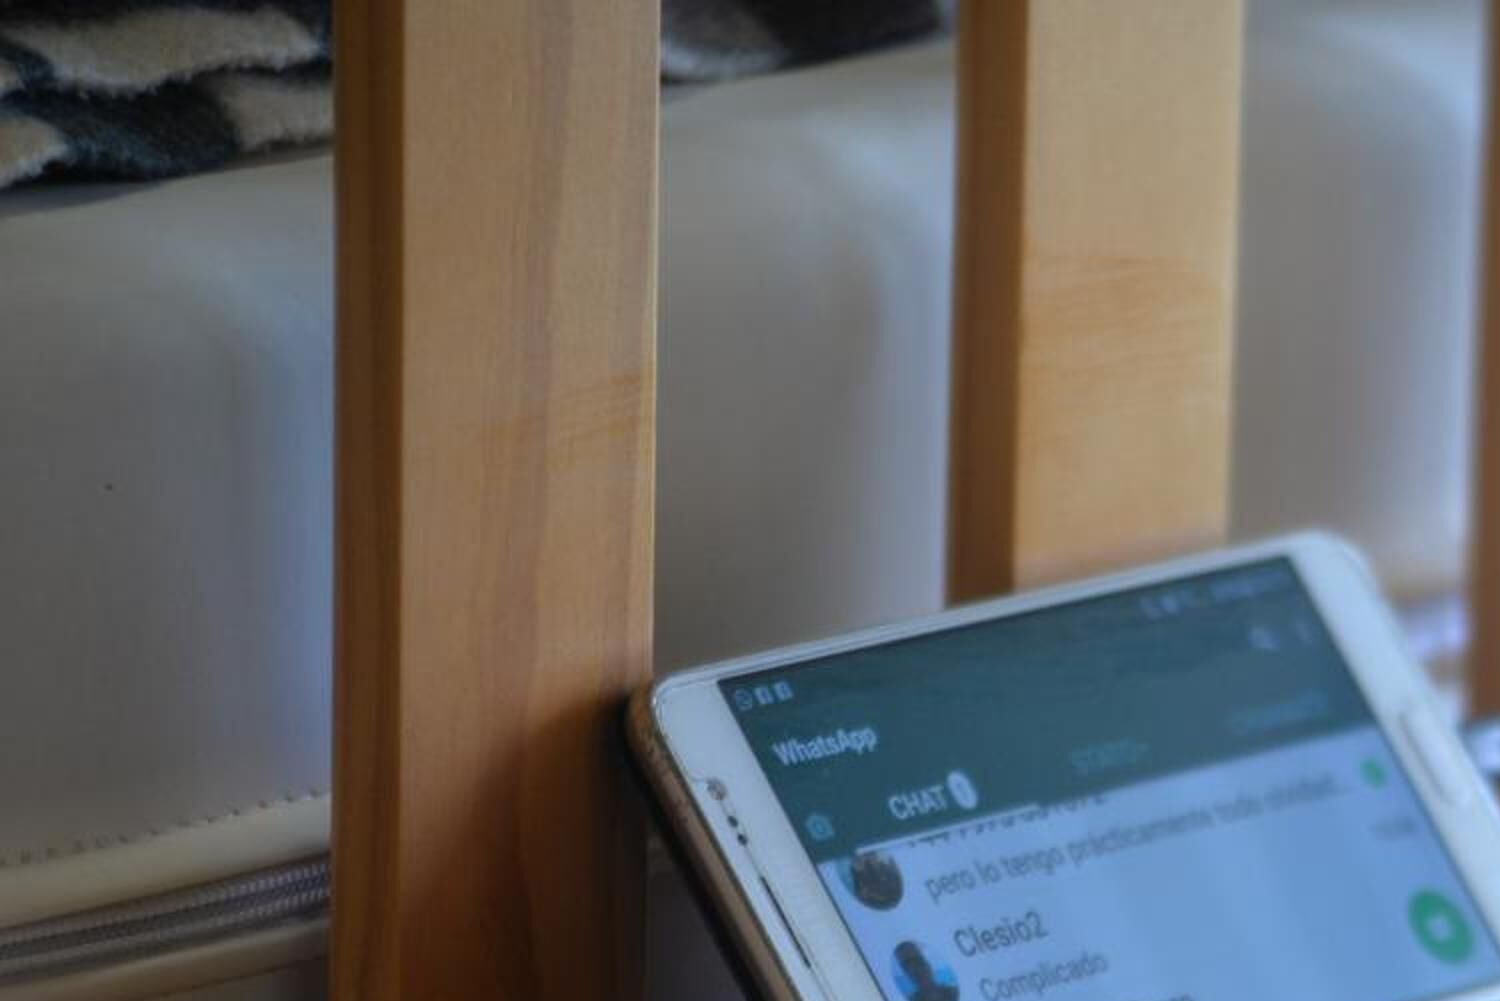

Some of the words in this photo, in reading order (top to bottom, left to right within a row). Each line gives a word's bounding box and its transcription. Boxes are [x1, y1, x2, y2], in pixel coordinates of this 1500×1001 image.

[772, 727, 877, 766] WhatsApp
[888, 784, 948, 820] CHAT
[926, 868, 977, 905] pero
[974, 858, 1001, 885] lo
[1001, 846, 1066, 877] tengo
[953, 910, 1048, 957] Clesio2
